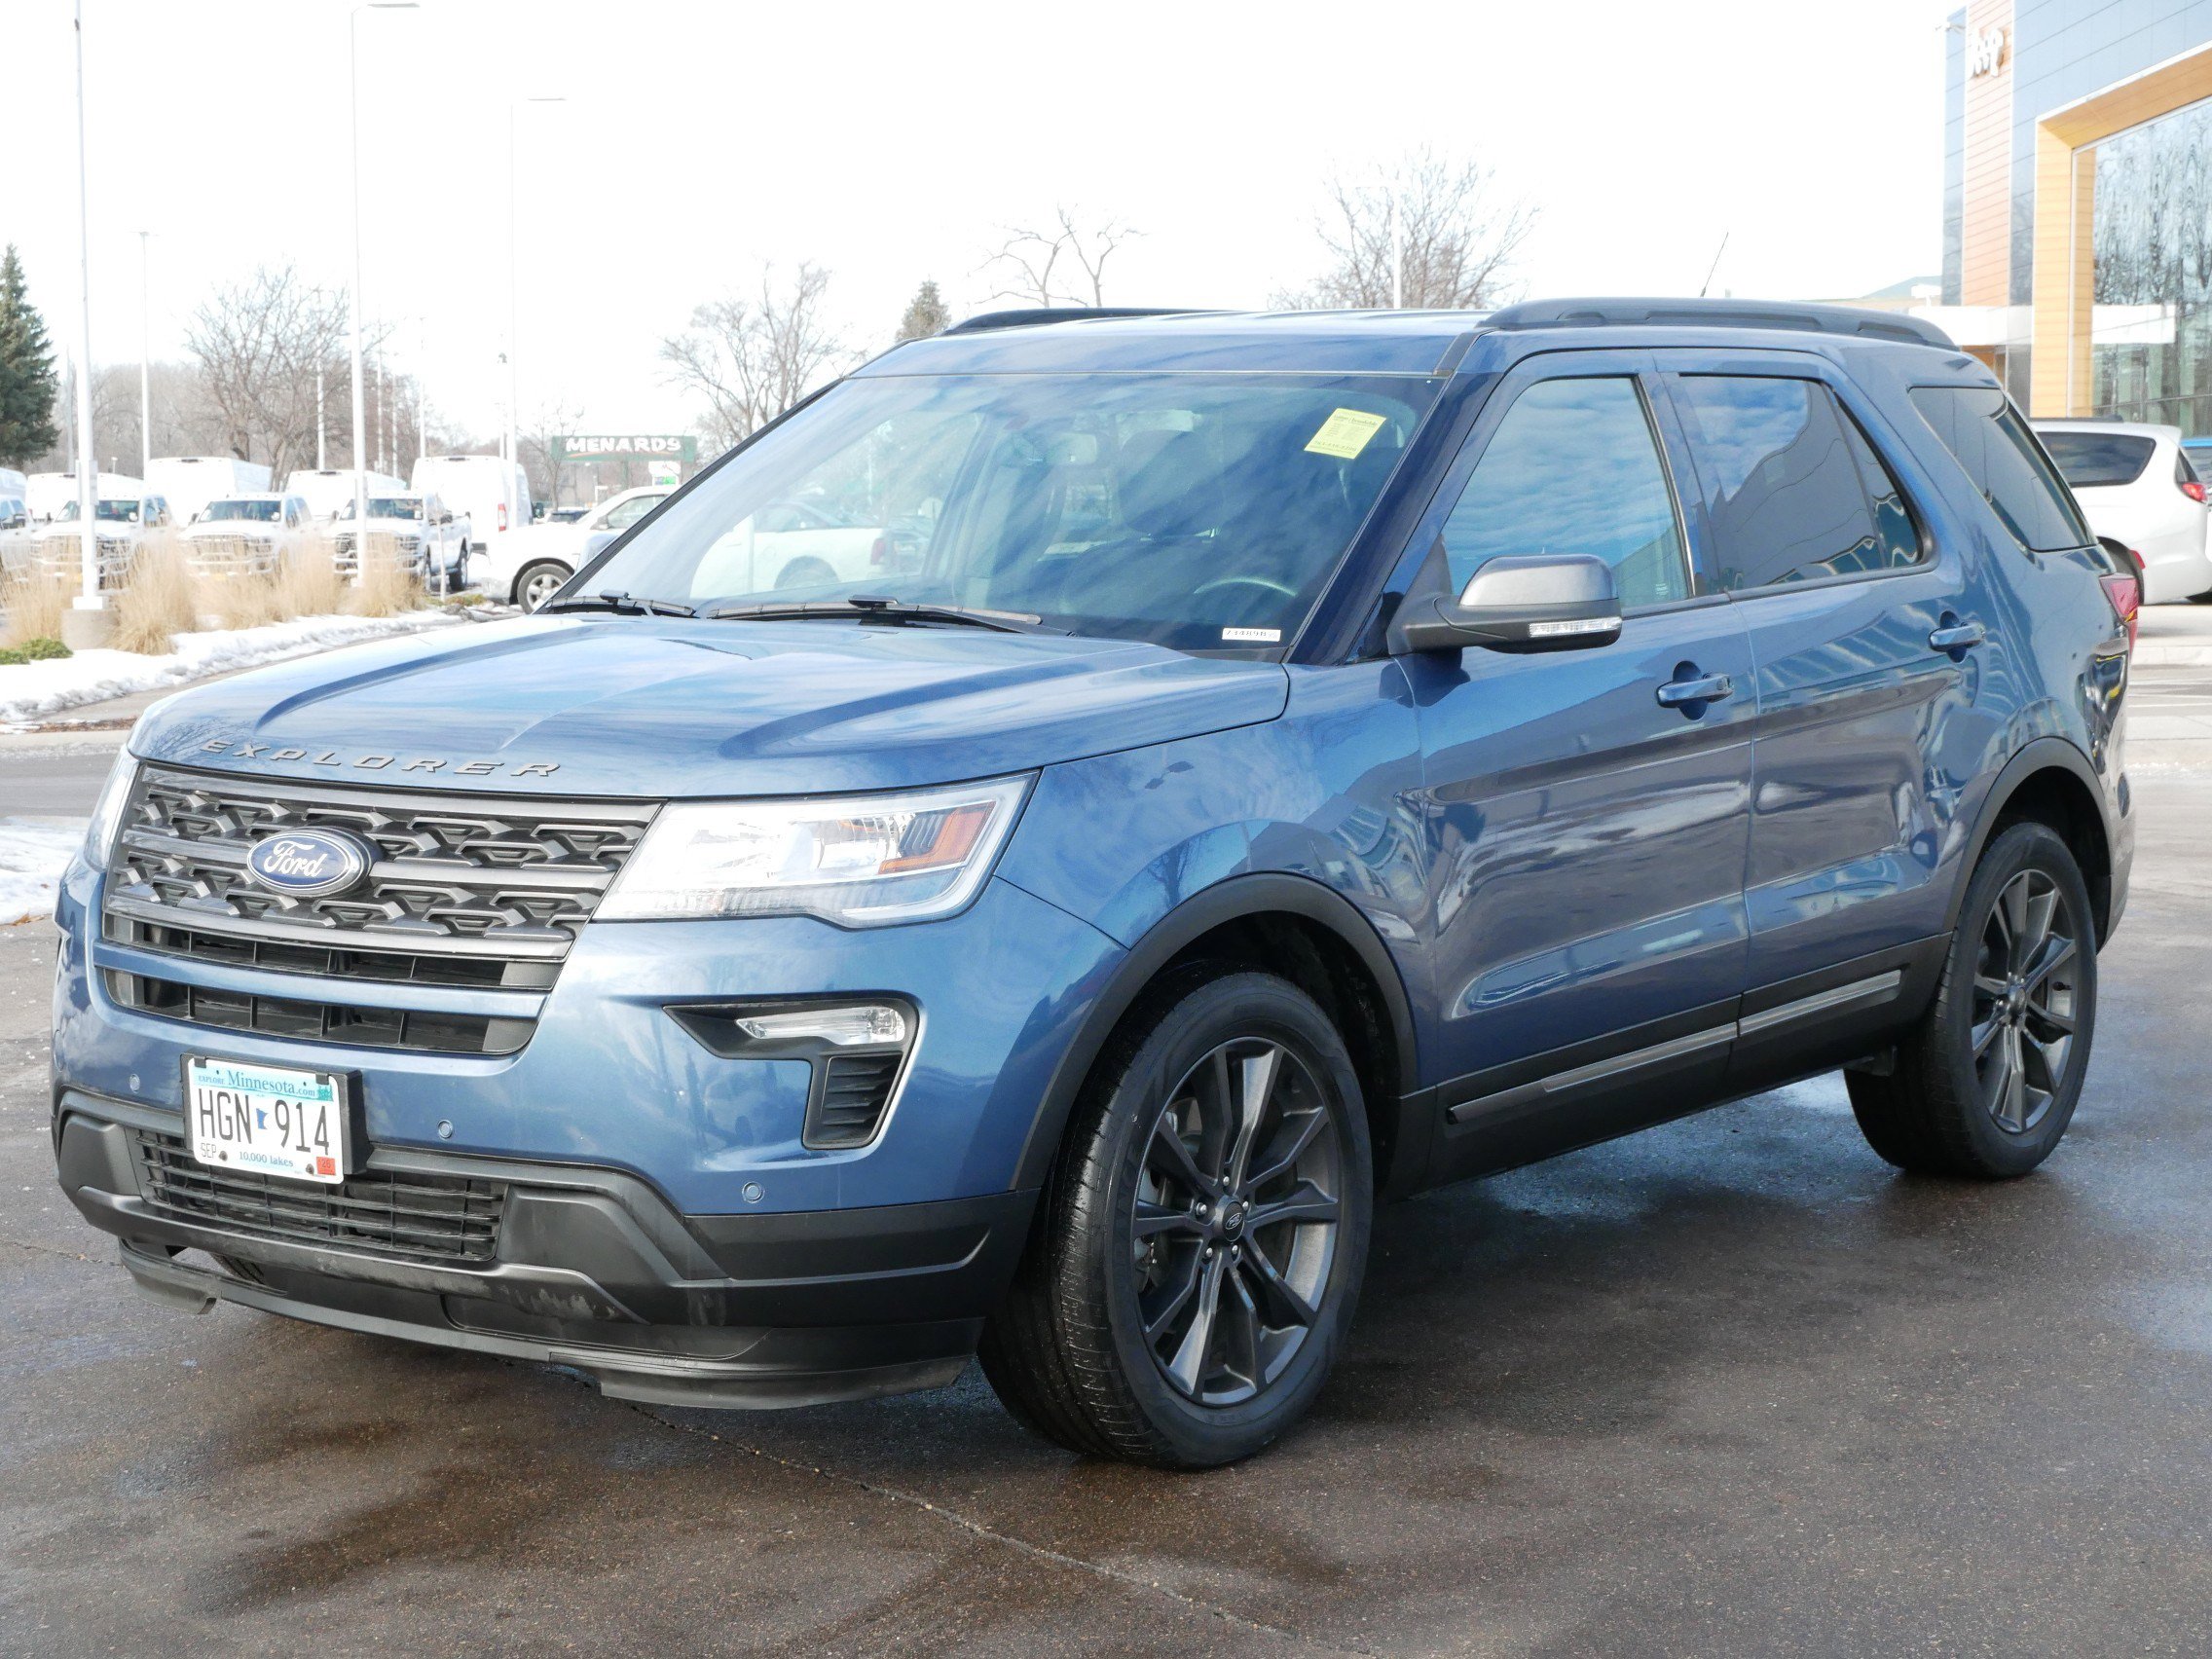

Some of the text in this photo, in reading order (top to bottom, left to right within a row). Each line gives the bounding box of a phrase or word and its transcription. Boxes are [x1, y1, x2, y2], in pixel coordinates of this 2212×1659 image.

[566, 437, 682, 453] MENARDS
[200, 740, 561, 777] EXPLORER
[263, 840, 328, 878] Ford
[199, 1088, 330, 1156] HGN 914
[201, 1142, 217, 1159] SEP
[239, 1151, 294, 1167] 10,000 lakes
